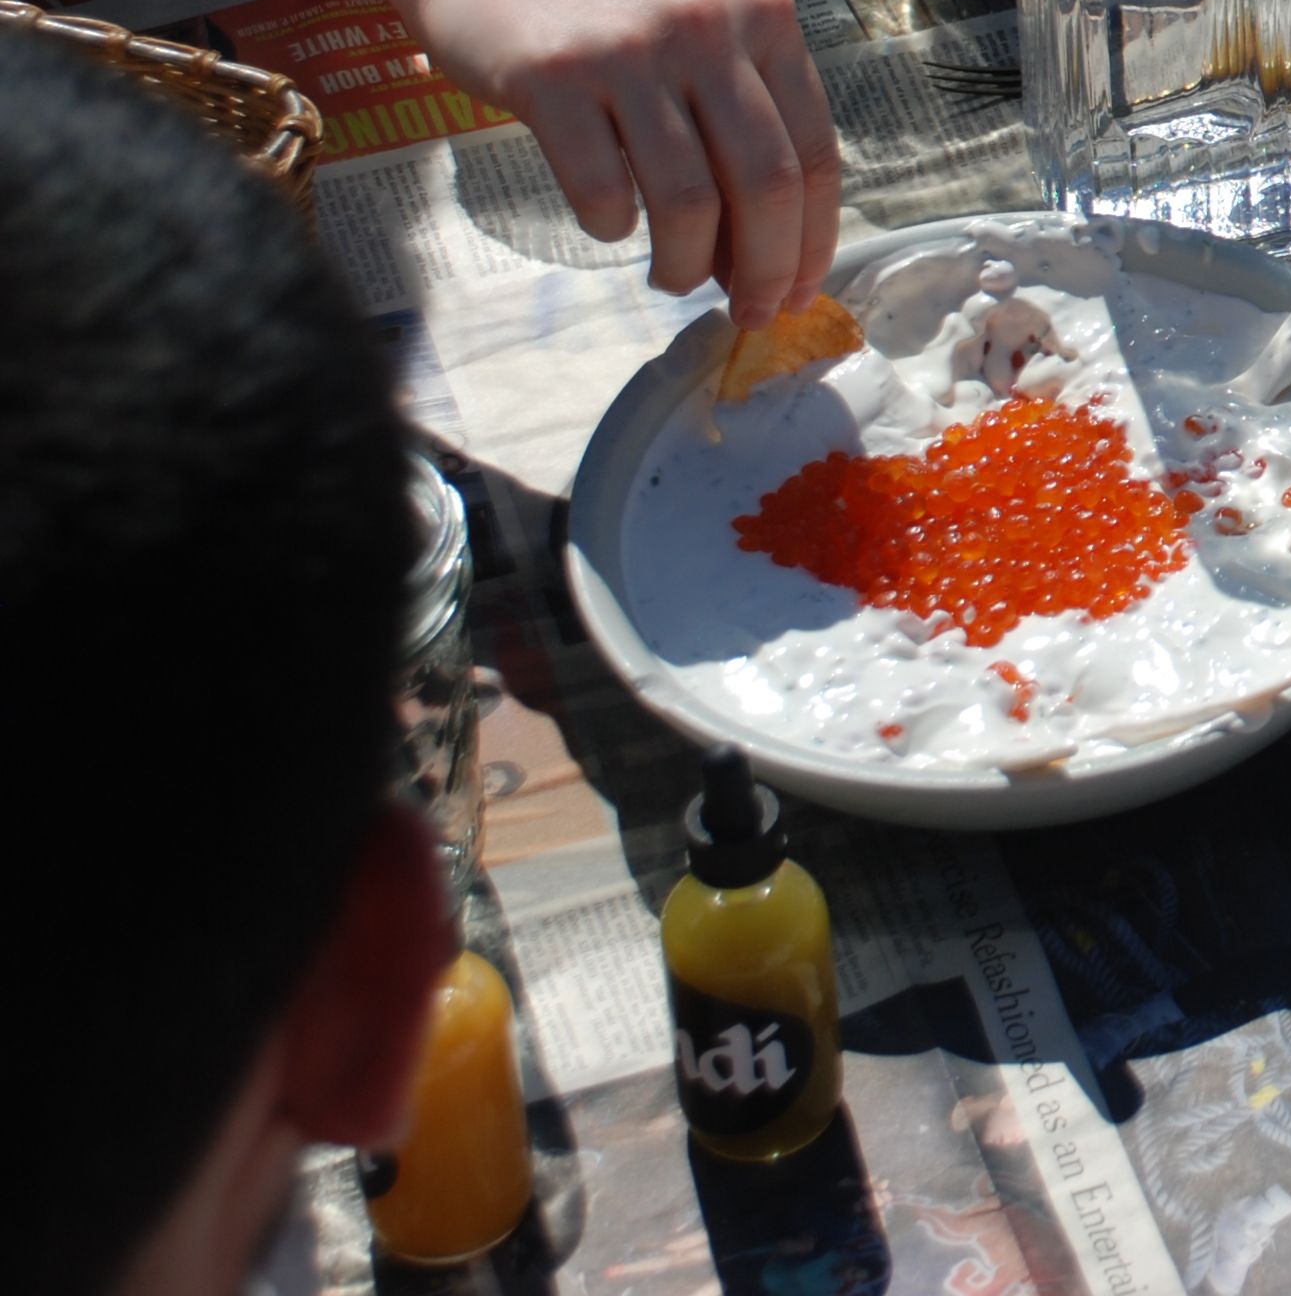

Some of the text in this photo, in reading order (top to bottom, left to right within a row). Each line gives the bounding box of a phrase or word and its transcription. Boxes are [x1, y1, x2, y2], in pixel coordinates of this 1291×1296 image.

[288, 25, 370, 61] WHITE
[319, 64, 381, 93] BIOH
[971, 928, 1064, 1093] Refashioned
[1035, 1099, 1067, 1134] as
[1051, 1141, 1084, 1180] an
